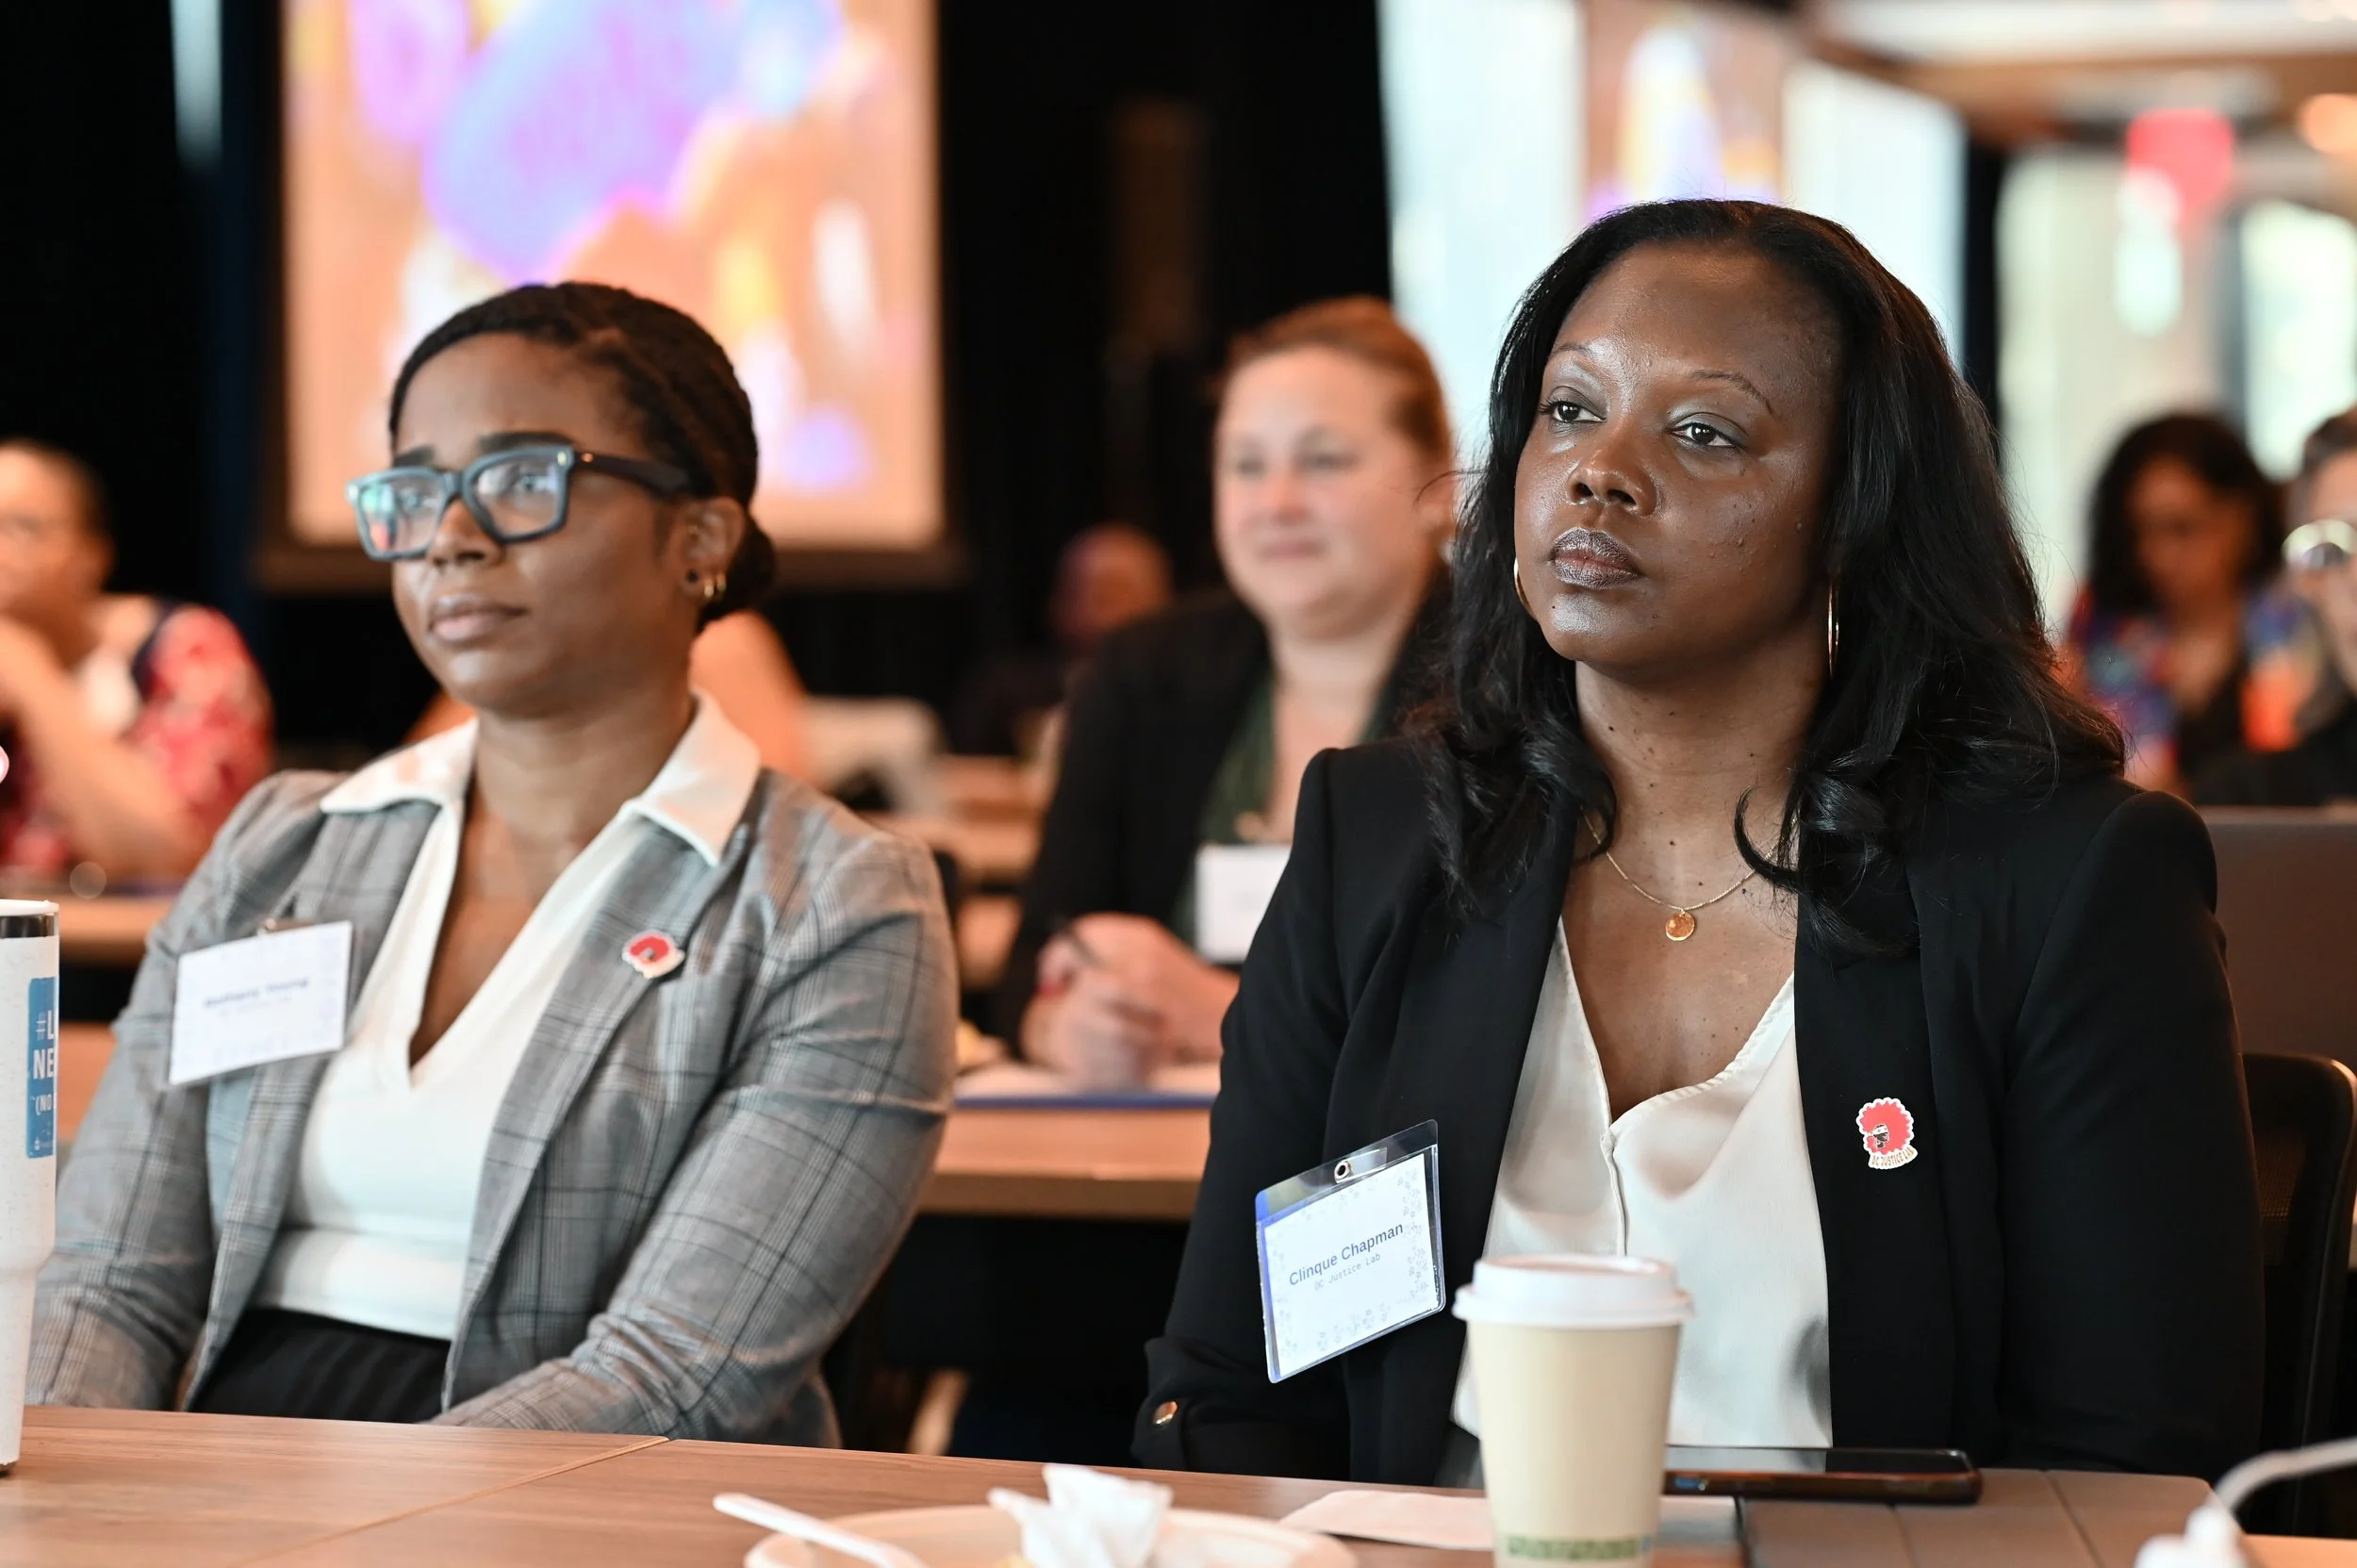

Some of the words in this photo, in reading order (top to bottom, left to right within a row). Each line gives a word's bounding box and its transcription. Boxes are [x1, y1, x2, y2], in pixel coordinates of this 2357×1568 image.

[1289, 1255, 1338, 1285] Clinque
[1341, 1224, 1404, 1261] Chapman
[1328, 1263, 1361, 1284] Justice
[1365, 1253, 1381, 1265] Lab
